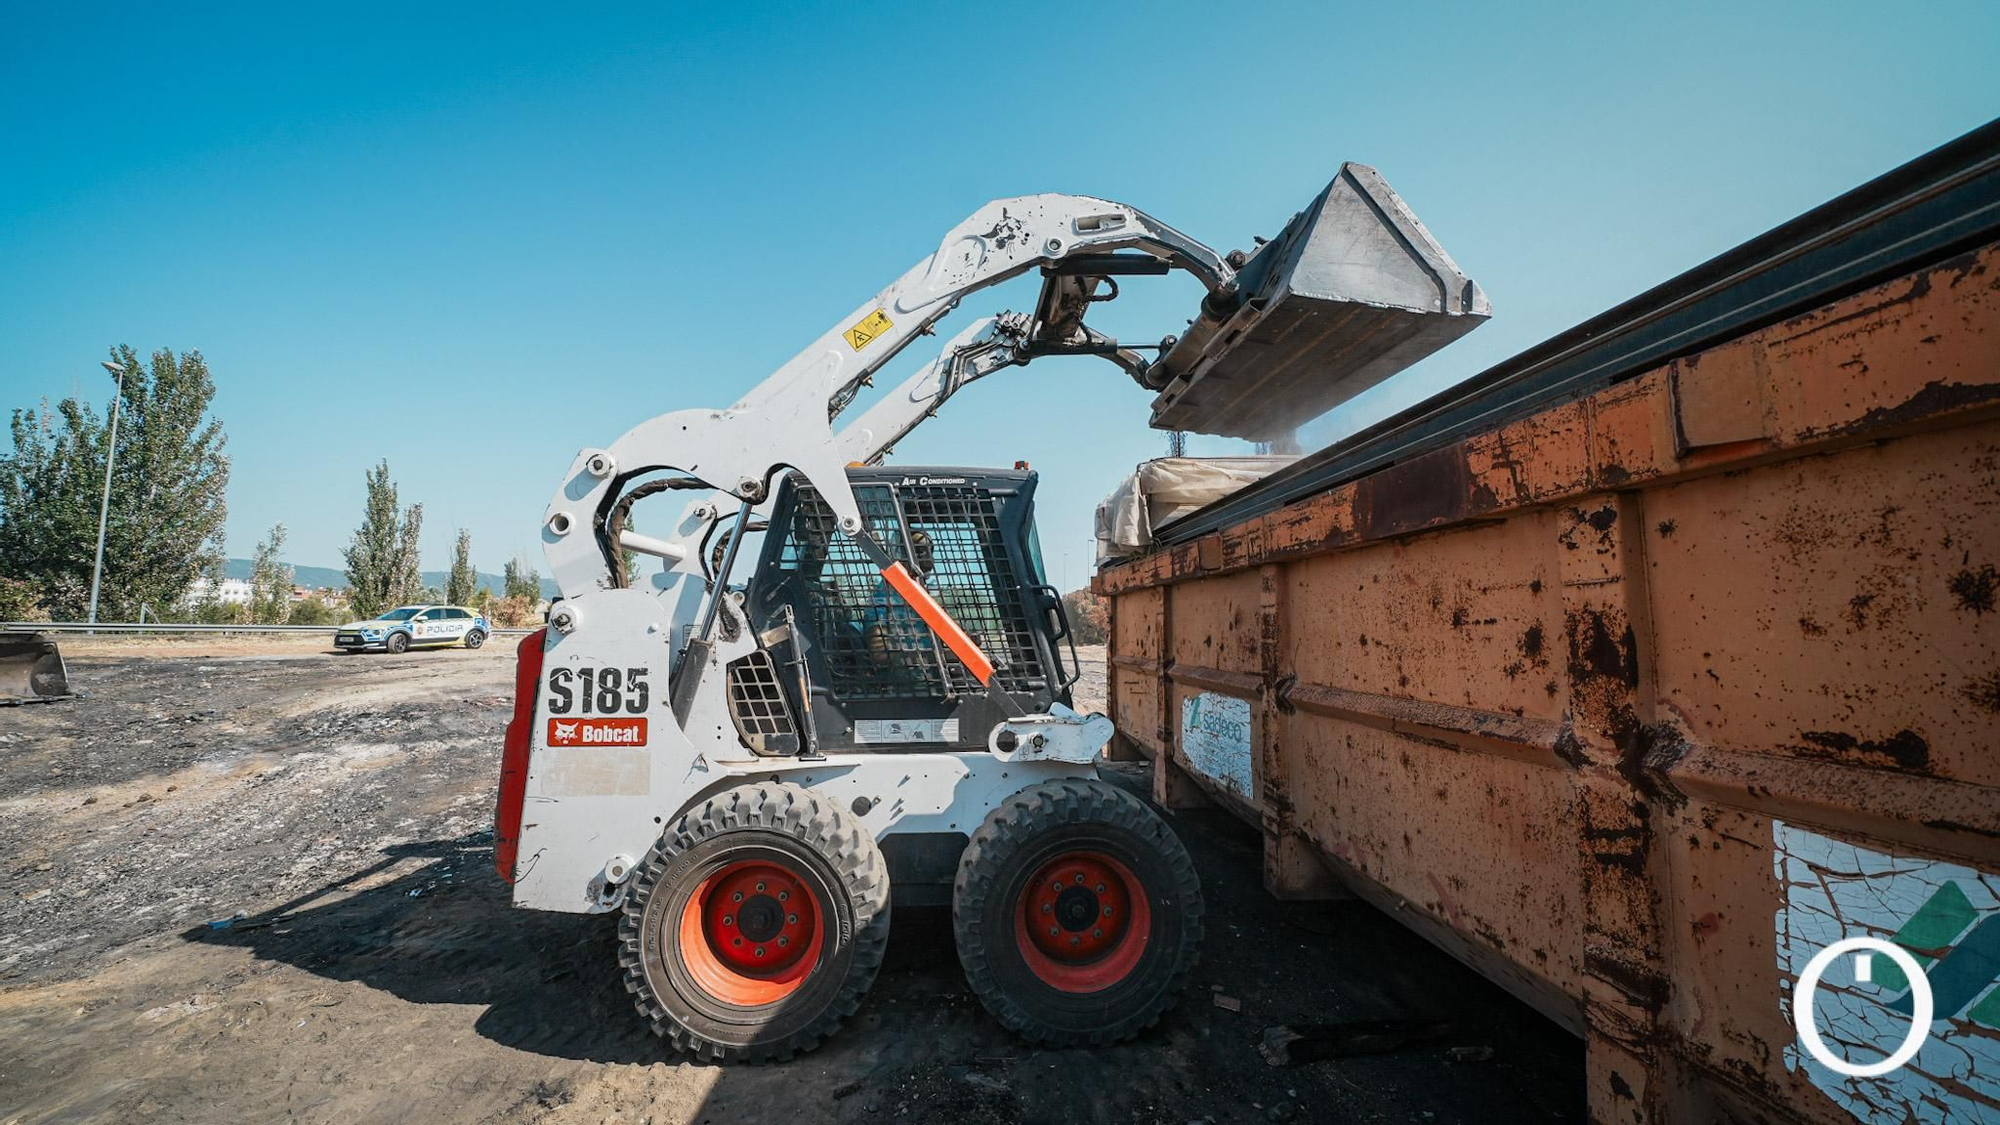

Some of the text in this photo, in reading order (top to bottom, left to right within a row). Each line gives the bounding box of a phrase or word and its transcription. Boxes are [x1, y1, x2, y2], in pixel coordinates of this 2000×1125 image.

[919, 476, 966, 486] CONDITIONED
[548, 667, 649, 714] S185
[582, 725, 639, 743] Bobcat
